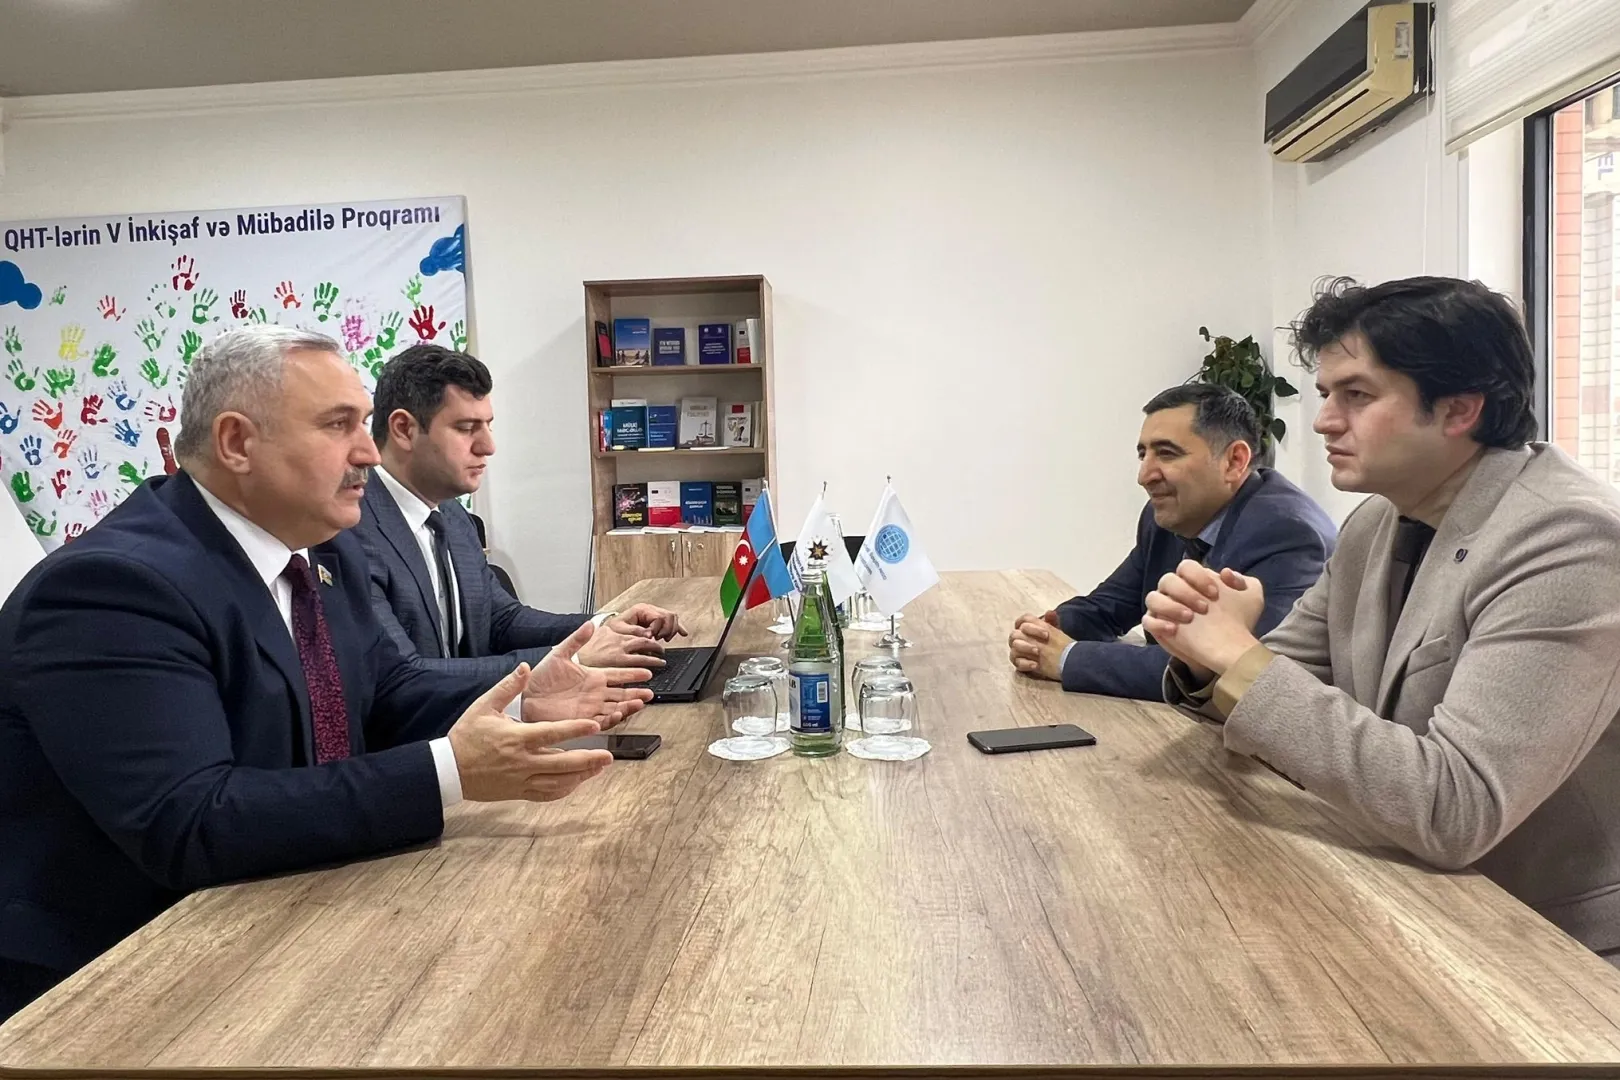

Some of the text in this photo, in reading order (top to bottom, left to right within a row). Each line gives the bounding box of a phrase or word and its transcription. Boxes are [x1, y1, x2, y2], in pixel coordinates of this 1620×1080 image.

[4, 205, 440, 252] QHT-lərin V İnkişaf və Mübadilə Proqramı
